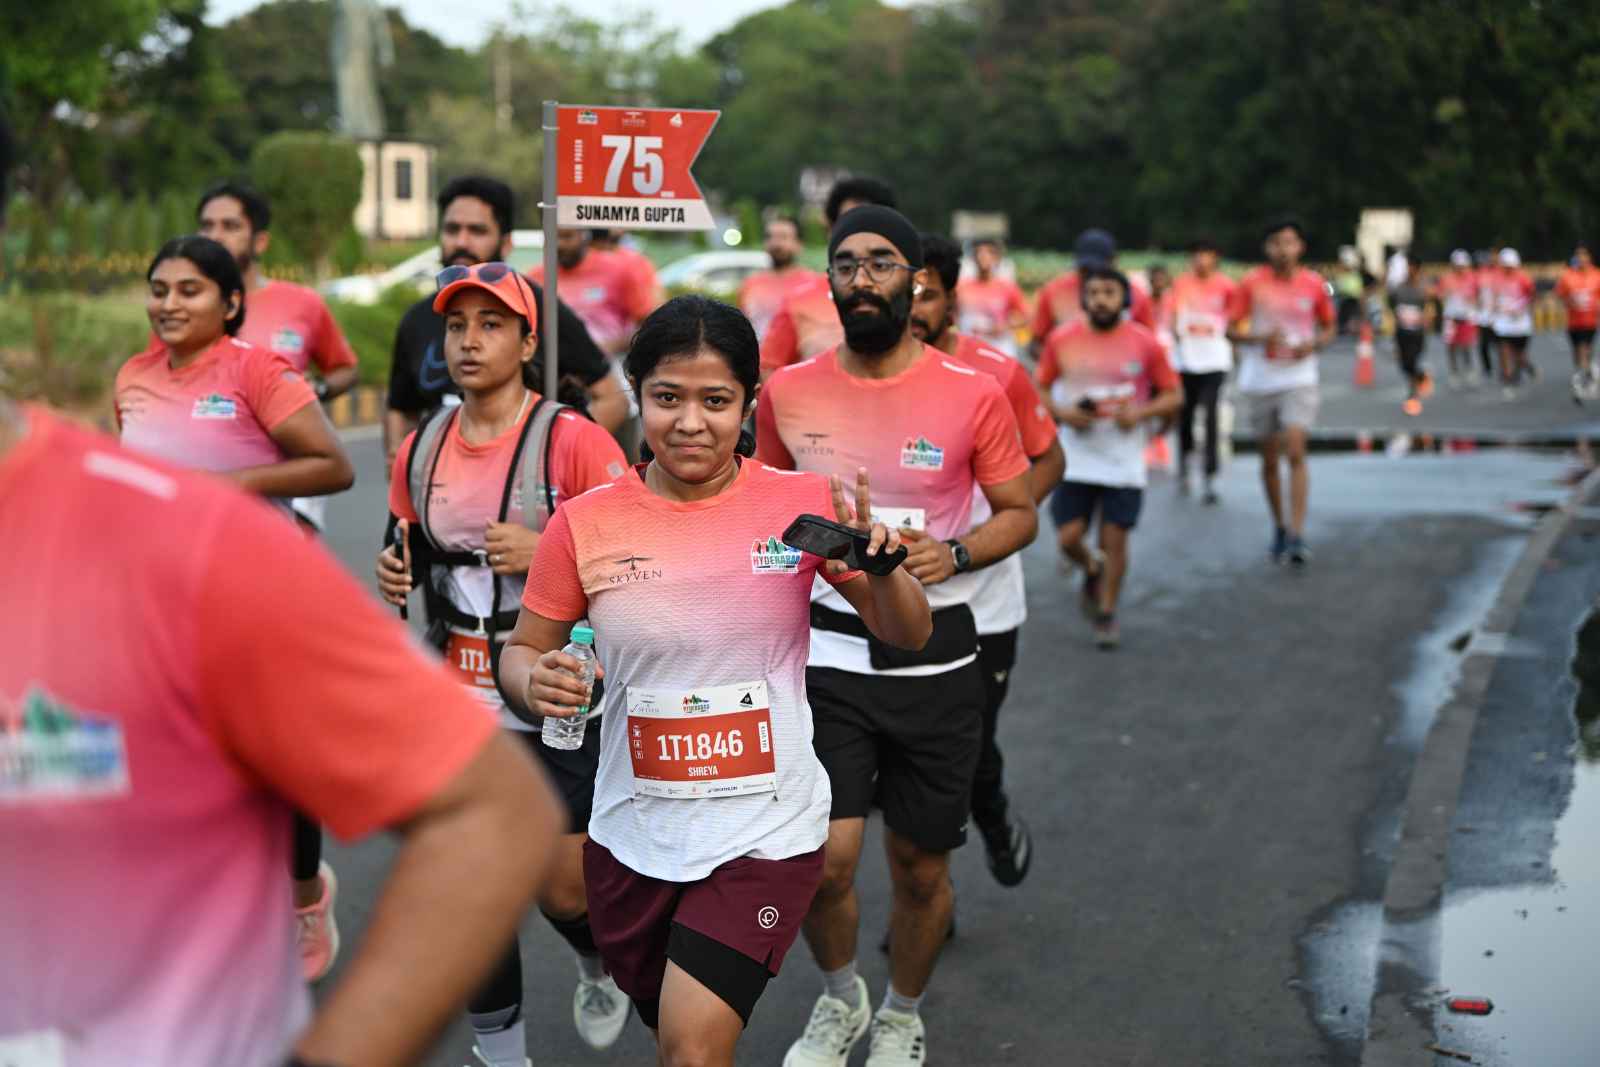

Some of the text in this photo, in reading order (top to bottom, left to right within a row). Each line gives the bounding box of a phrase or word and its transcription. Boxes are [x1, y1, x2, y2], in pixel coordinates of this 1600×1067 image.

[601, 134, 664, 194] 75
[576, 205, 685, 223] SUNAMYA GUPTA
[608, 568, 663, 585] SKYVEN
[657, 729, 744, 761] 1T1846
[687, 765, 719, 777] SHREYA
